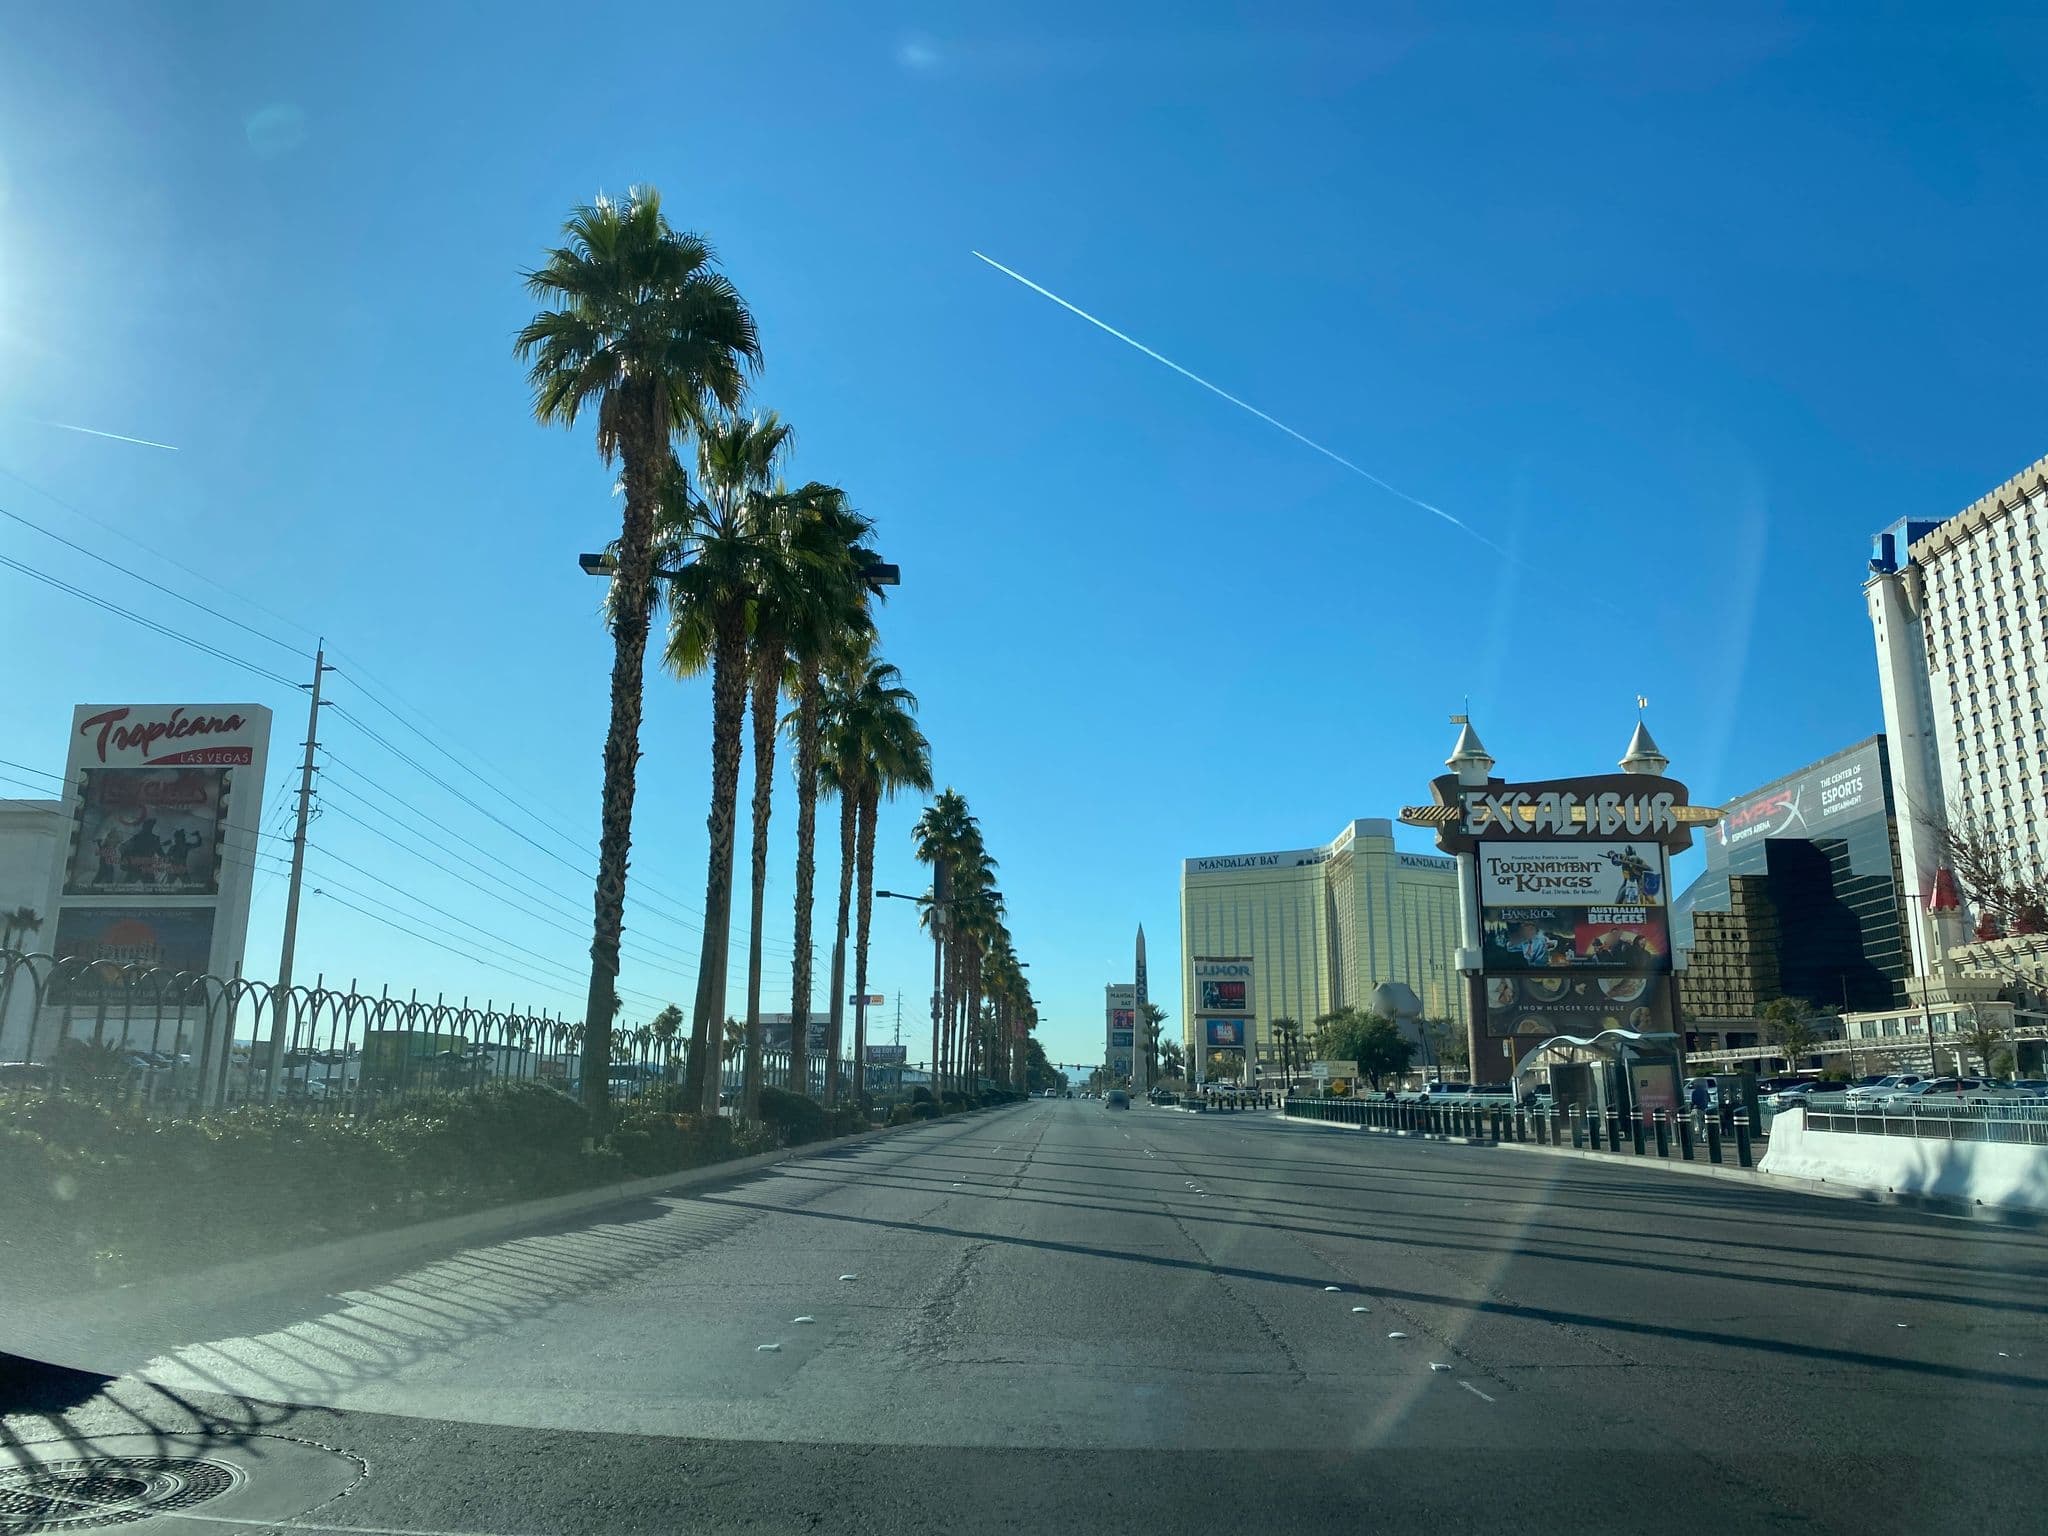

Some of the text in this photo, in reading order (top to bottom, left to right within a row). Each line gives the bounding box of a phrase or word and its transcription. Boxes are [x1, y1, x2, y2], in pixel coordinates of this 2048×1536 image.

[80, 707, 247, 763] Tropicana
[180, 752, 249, 763] LAS VEGAS
[1820, 764, 1861, 788] THE CENTER OF
[1821, 776, 1863, 806] ESPORTS
[1465, 791, 1678, 835] EXCALIBUR
[1823, 794, 1862, 816] ENTERTAINMENT
[1731, 819, 1771, 843] ESPORTS ARENA
[1198, 854, 1280, 870] MANDALAY BAY
[1400, 855, 1450, 870] MANDALAY
[1487, 858, 1602, 876] TOURNAMENT
[1514, 874, 1594, 892] KINGS
[1588, 914, 1644, 924] BEE GEES
[1590, 906, 1646, 914] AUSTRALIAN
[1195, 965, 1250, 976] LUXOR
